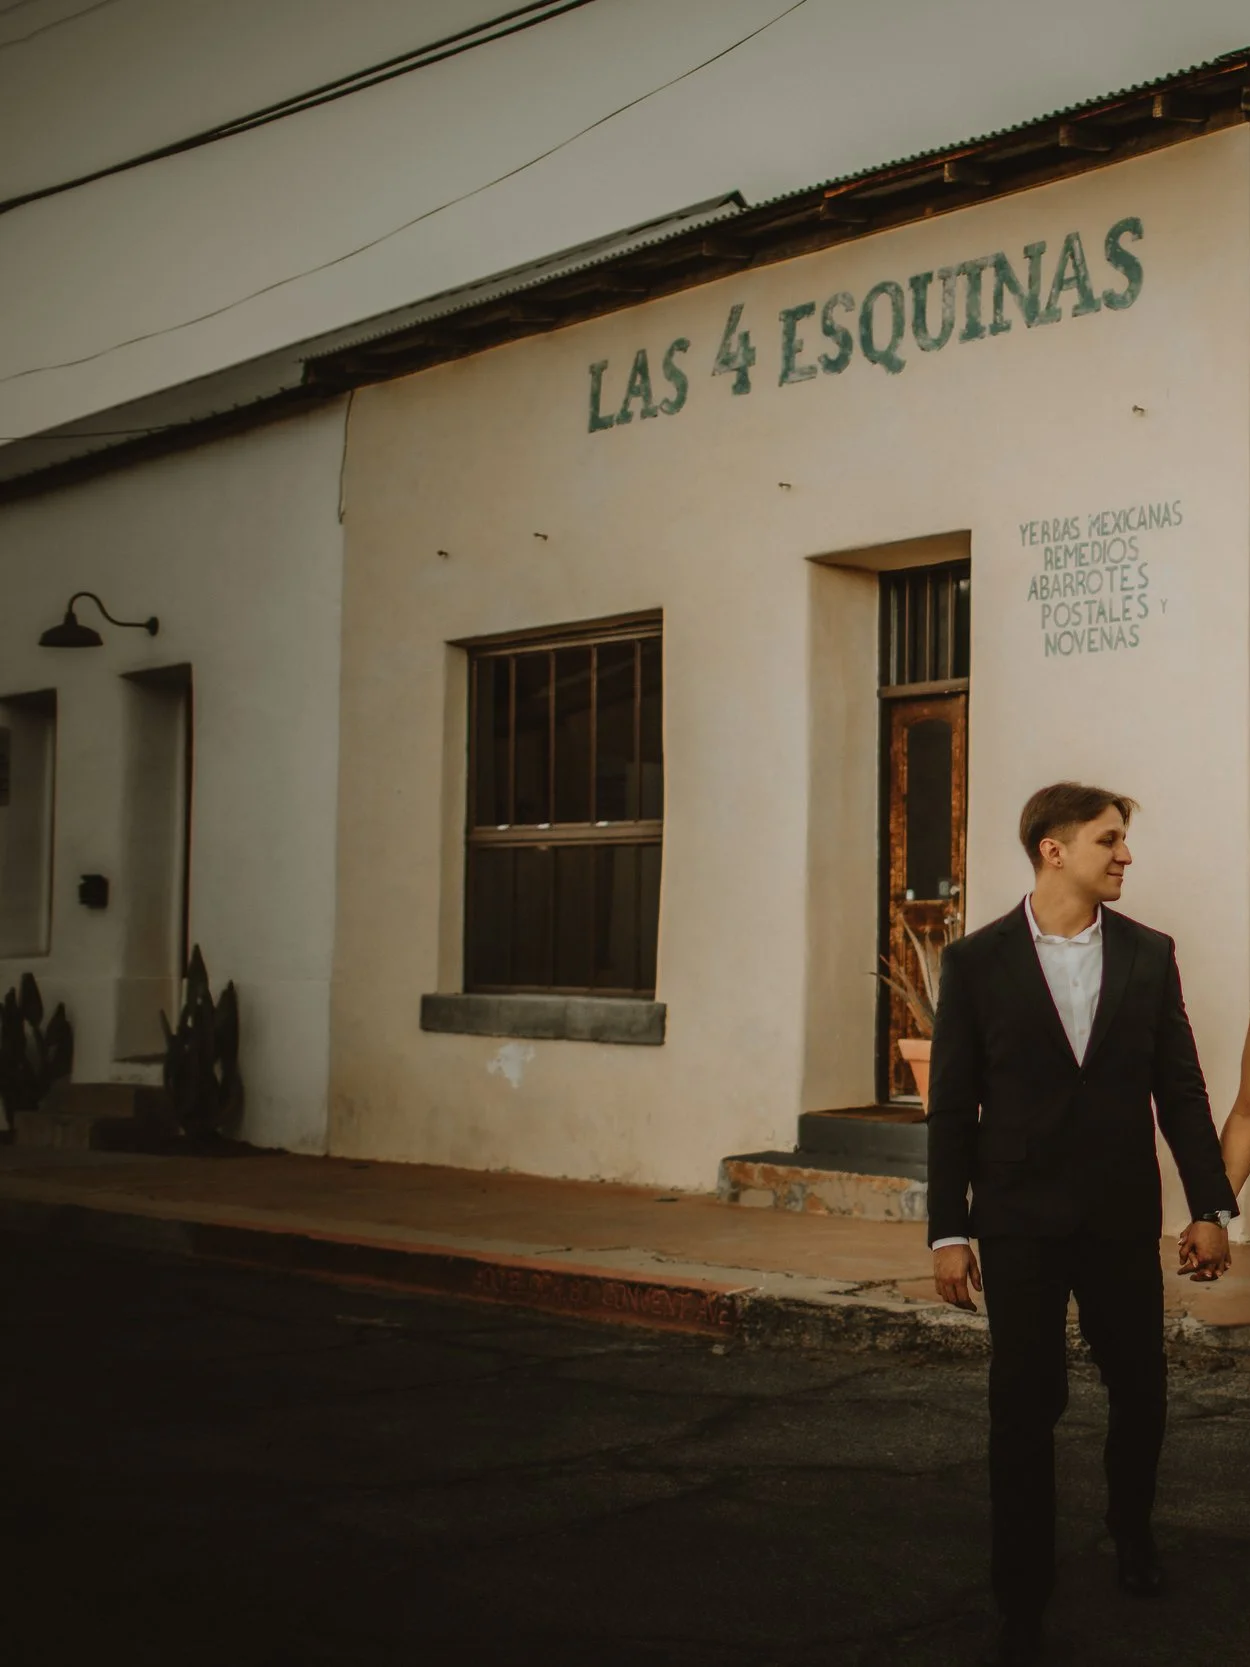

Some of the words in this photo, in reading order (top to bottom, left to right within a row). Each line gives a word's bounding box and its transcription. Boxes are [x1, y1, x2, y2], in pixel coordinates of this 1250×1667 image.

[589, 337, 690, 432] LAS
[711, 303, 756, 395] 4
[778, 216, 1144, 388] ESQUINAS
[1019, 516, 1081, 547] YERBAS
[1087, 499, 1183, 539] MEXICANAS
[1044, 535, 1140, 571] REMEDIOS
[1027, 562, 1149, 602] ABARROTES
[1041, 593, 1149, 629] POSTALES
[1044, 624, 1140, 657] NOVENAS
